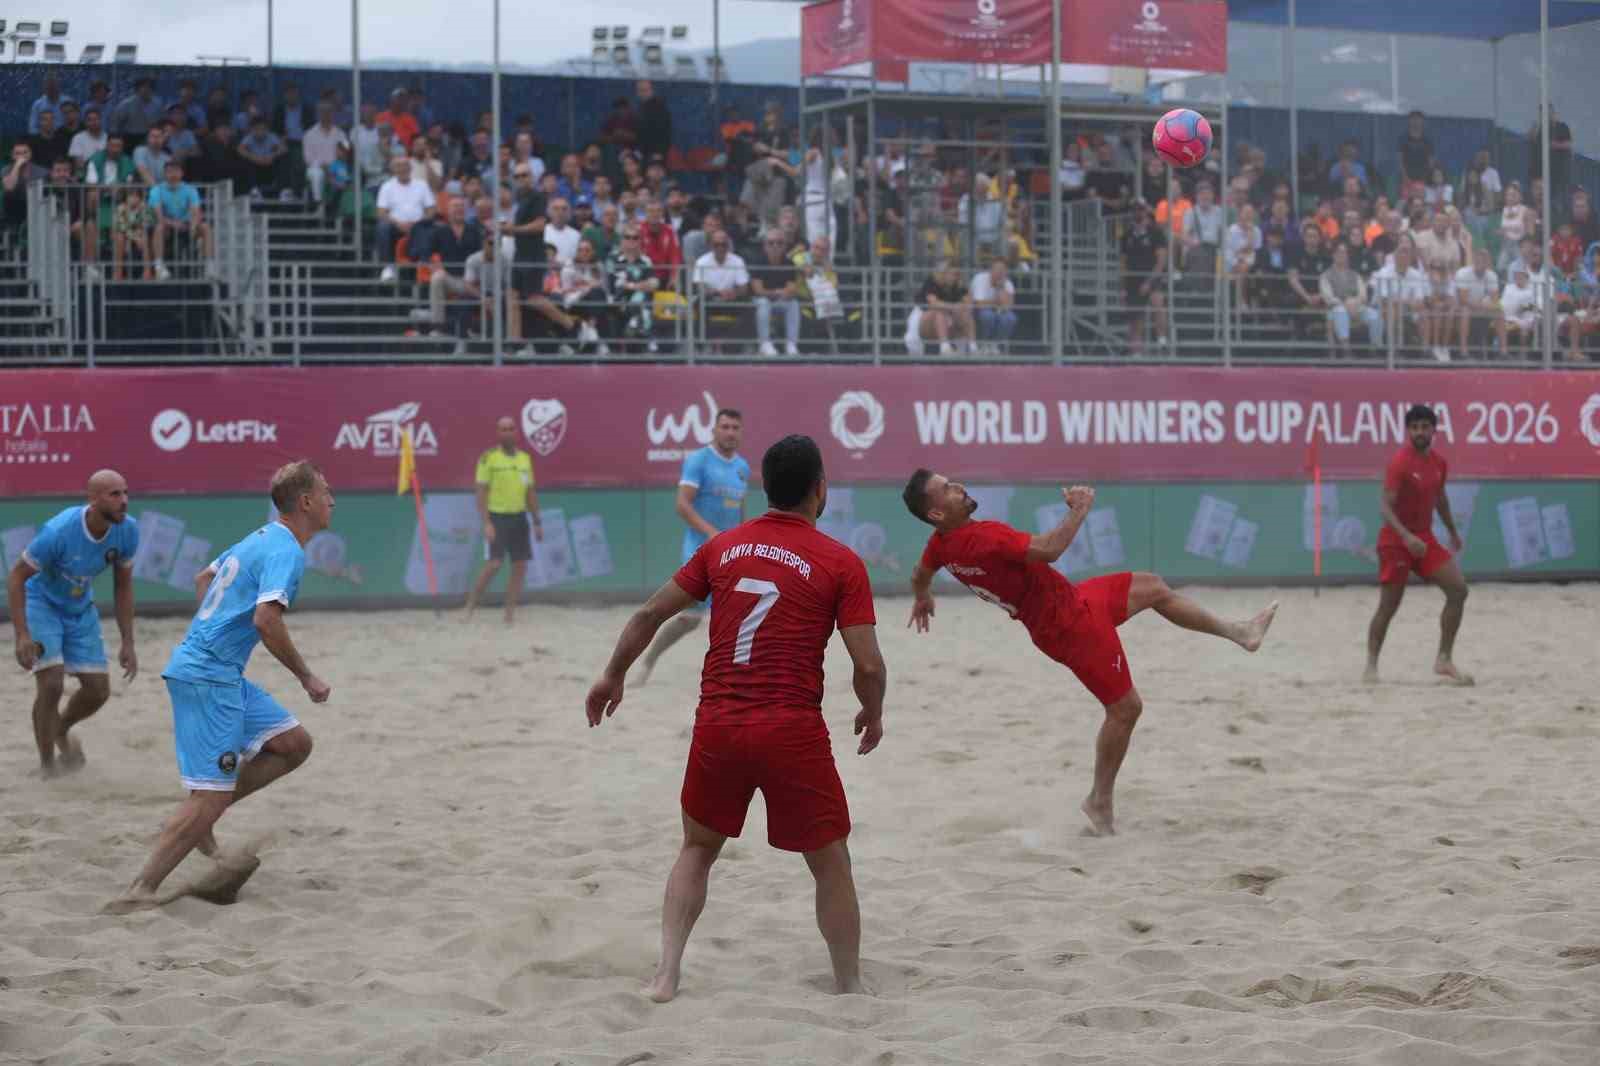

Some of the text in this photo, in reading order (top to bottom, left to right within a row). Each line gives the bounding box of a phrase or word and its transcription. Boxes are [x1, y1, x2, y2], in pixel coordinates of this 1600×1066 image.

[196, 419, 278, 443] LetFix
[914, 400, 1559, 445] WORLD WINNERS CUP ALANA 2026
[719, 543, 753, 568] ALANYA
[198, 555, 240, 620] 8
[732, 577, 781, 665] 7
